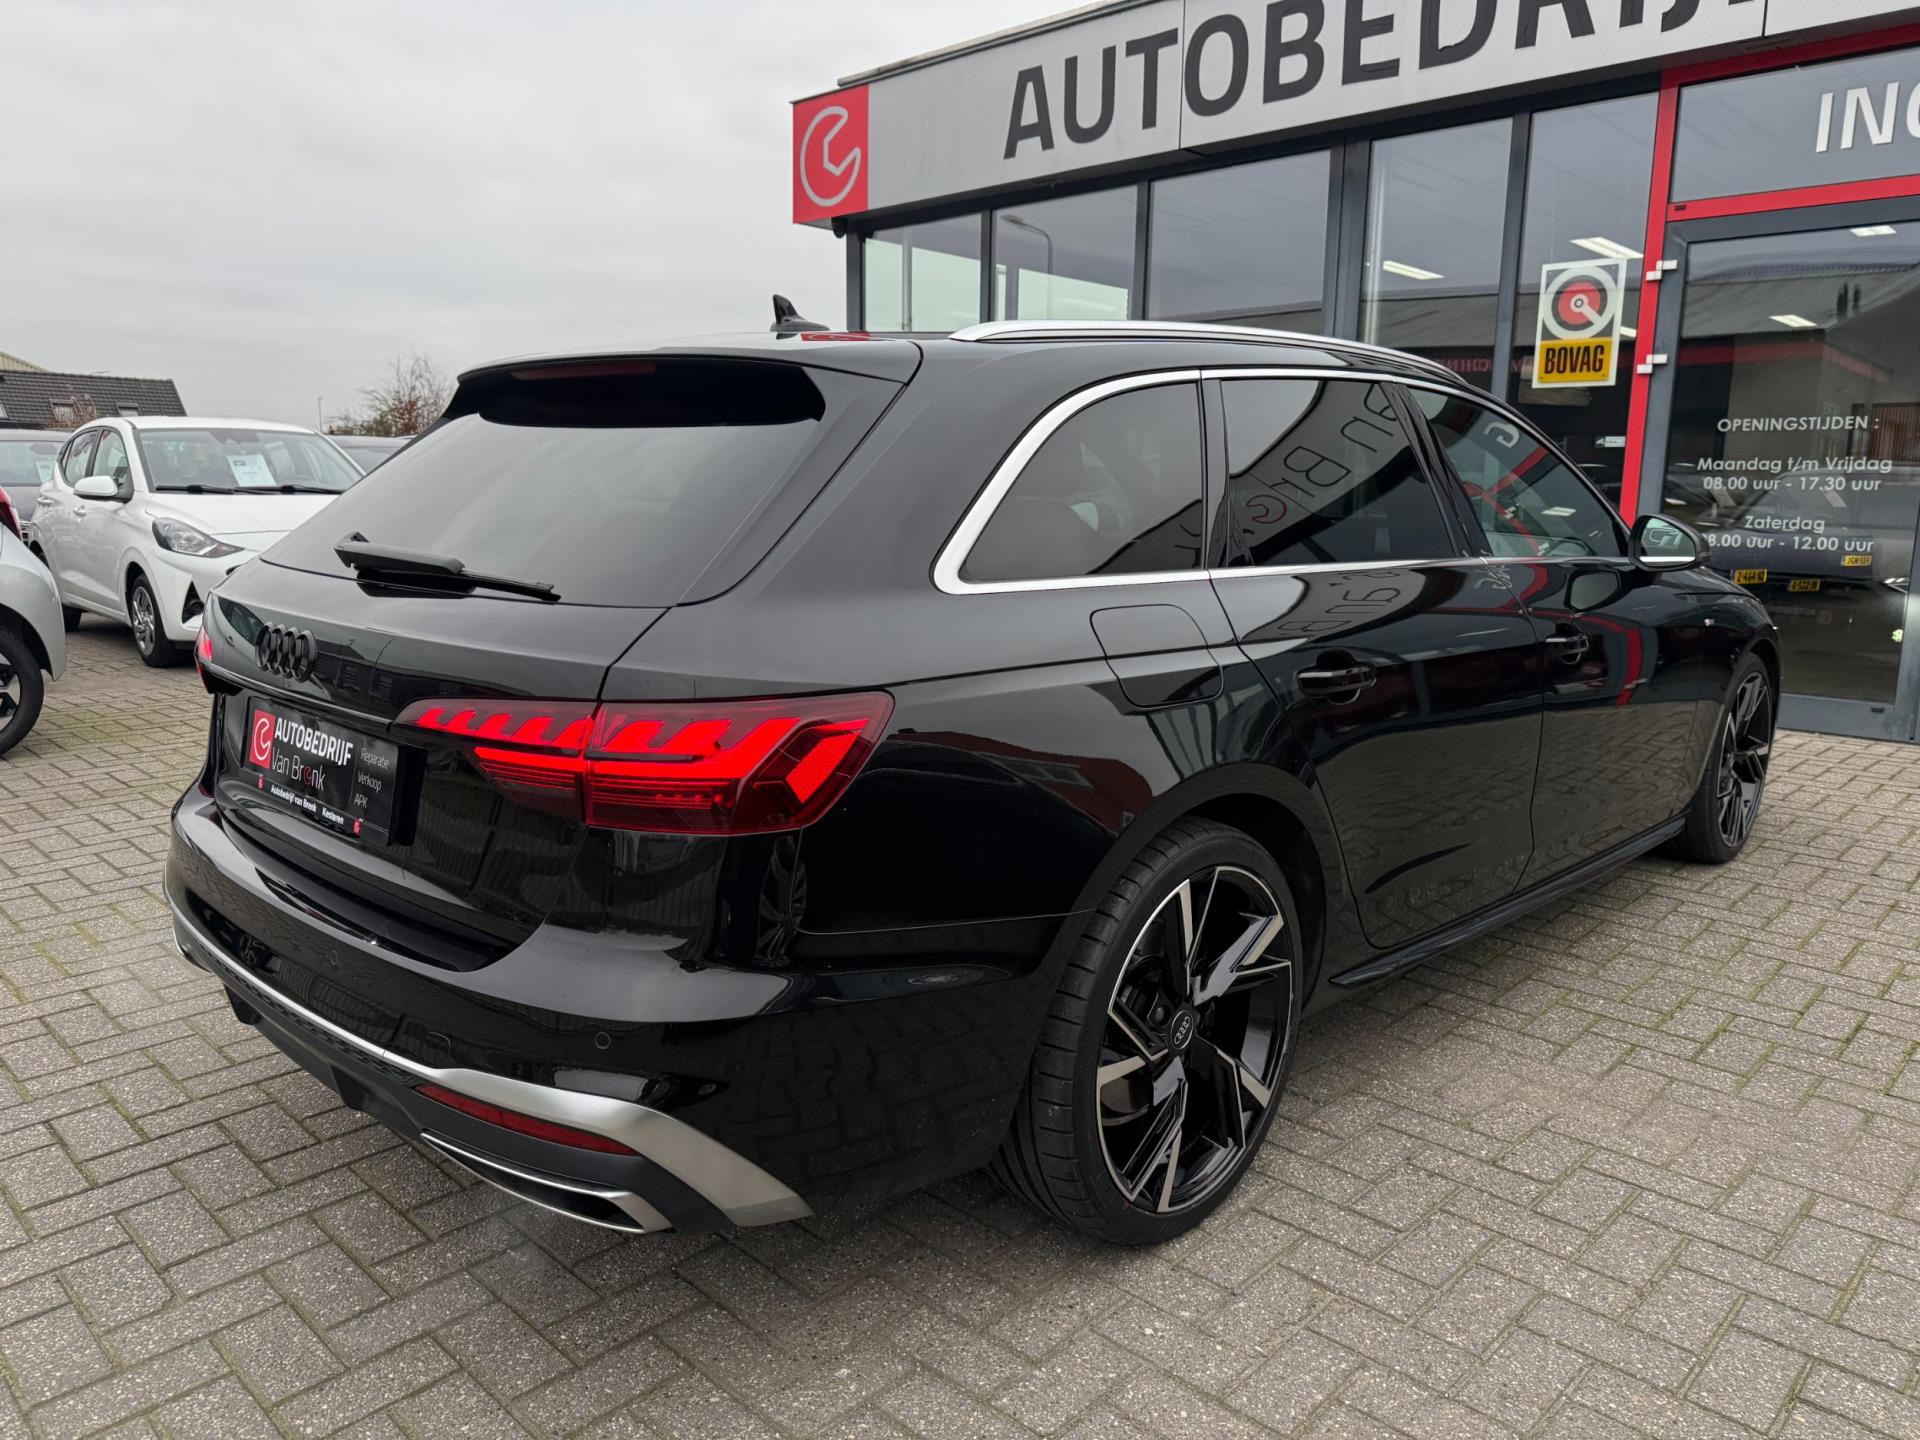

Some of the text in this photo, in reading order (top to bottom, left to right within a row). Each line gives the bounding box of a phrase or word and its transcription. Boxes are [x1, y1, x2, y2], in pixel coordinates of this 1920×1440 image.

[1003, 0, 1750, 158] AUTOBED
[1816, 82, 1920, 153] IN
[1544, 345, 1604, 374] BOVAG
[1717, 416, 1869, 432] OPENINGSTIJDEN
[1697, 457, 1893, 473] Maandag t/m Vrijdag
[1703, 477, 1748, 489] 08.00
[1753, 479, 1781, 490] uur
[1800, 477, 1846, 490] 17.30
[1852, 479, 1881, 491] uur
[1744, 516, 1825, 533] Zaterdag
[1702, 533, 1742, 547] 8.00
[1746, 536, 1774, 548] uur
[1793, 537, 1838, 550] 12.00
[1844, 539, 1874, 551] uur
[274, 717, 354, 766] AUTOBEDRIJF
[271, 746, 290, 775] Van
[360, 747, 390, 770] Reparatie
[357, 771, 382, 793] Verkoop
[270, 784, 344, 825] Autobedrijf van Brenk Kesteren
[353, 793, 368, 808] APK
